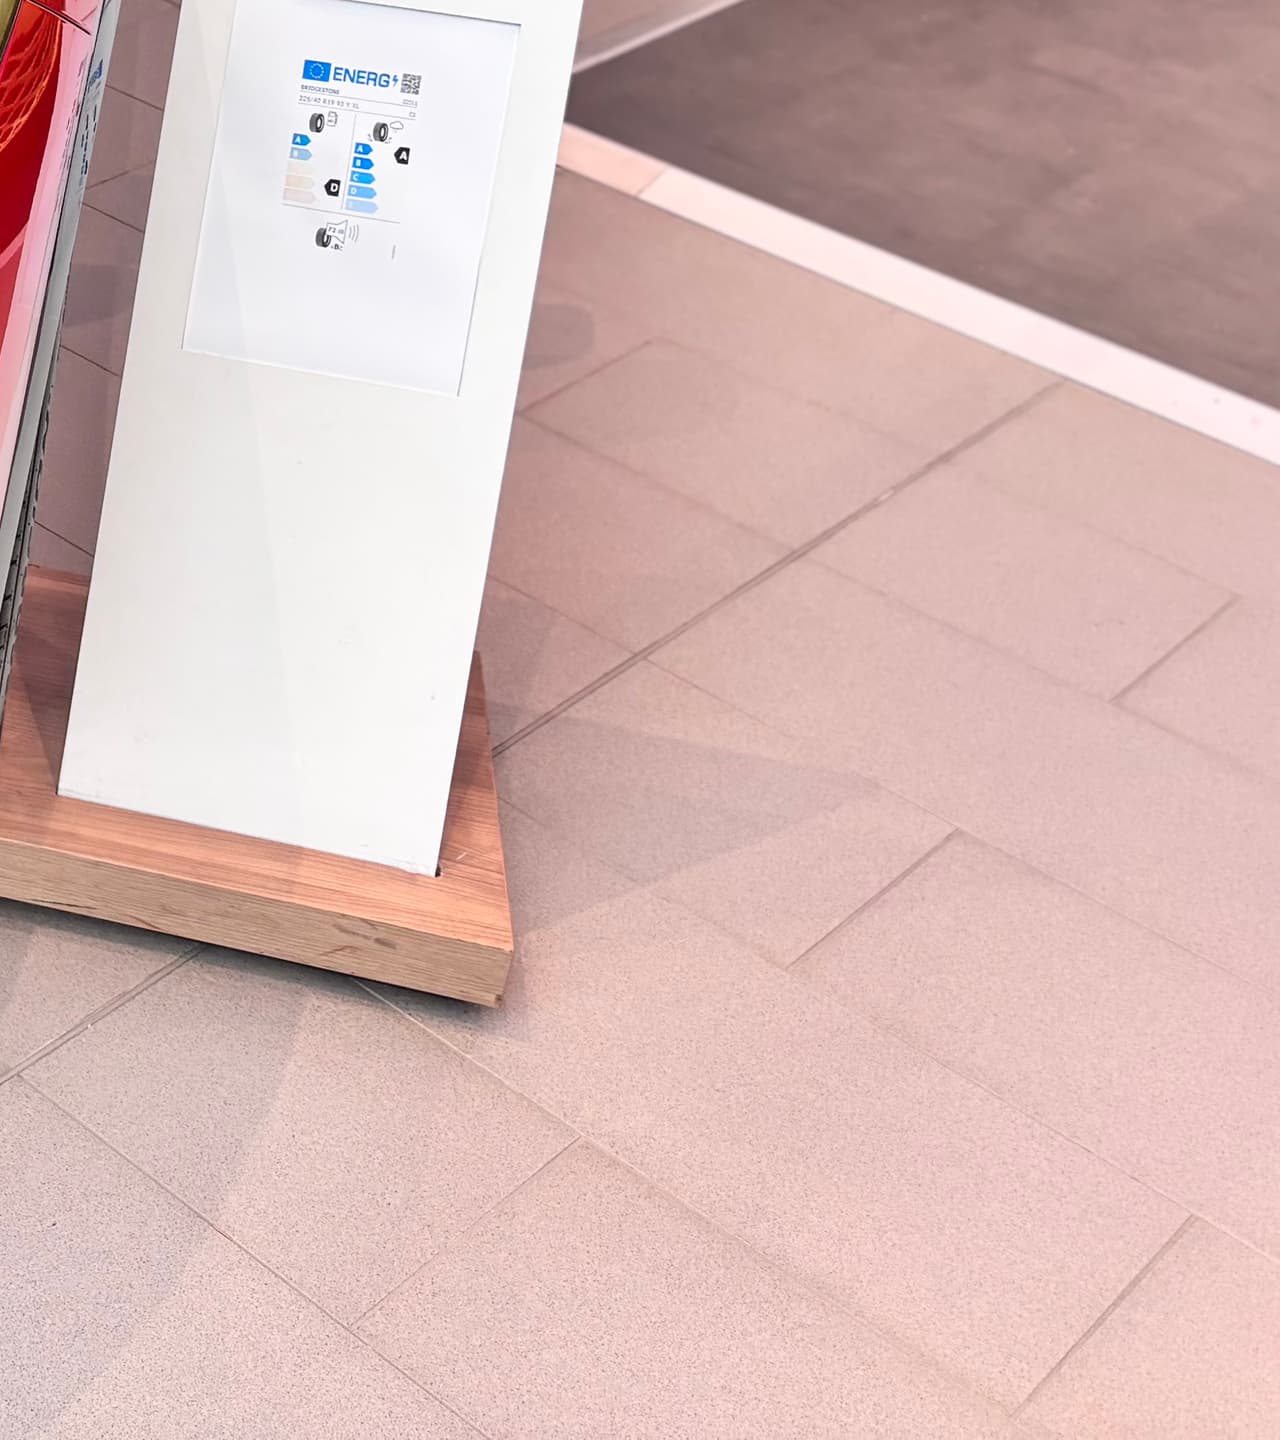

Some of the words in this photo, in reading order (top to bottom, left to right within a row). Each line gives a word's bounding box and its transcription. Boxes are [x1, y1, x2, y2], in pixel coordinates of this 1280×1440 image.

[333, 67, 390, 88] ENERG
[399, 151, 407, 160] A
[330, 184, 339, 192] D
